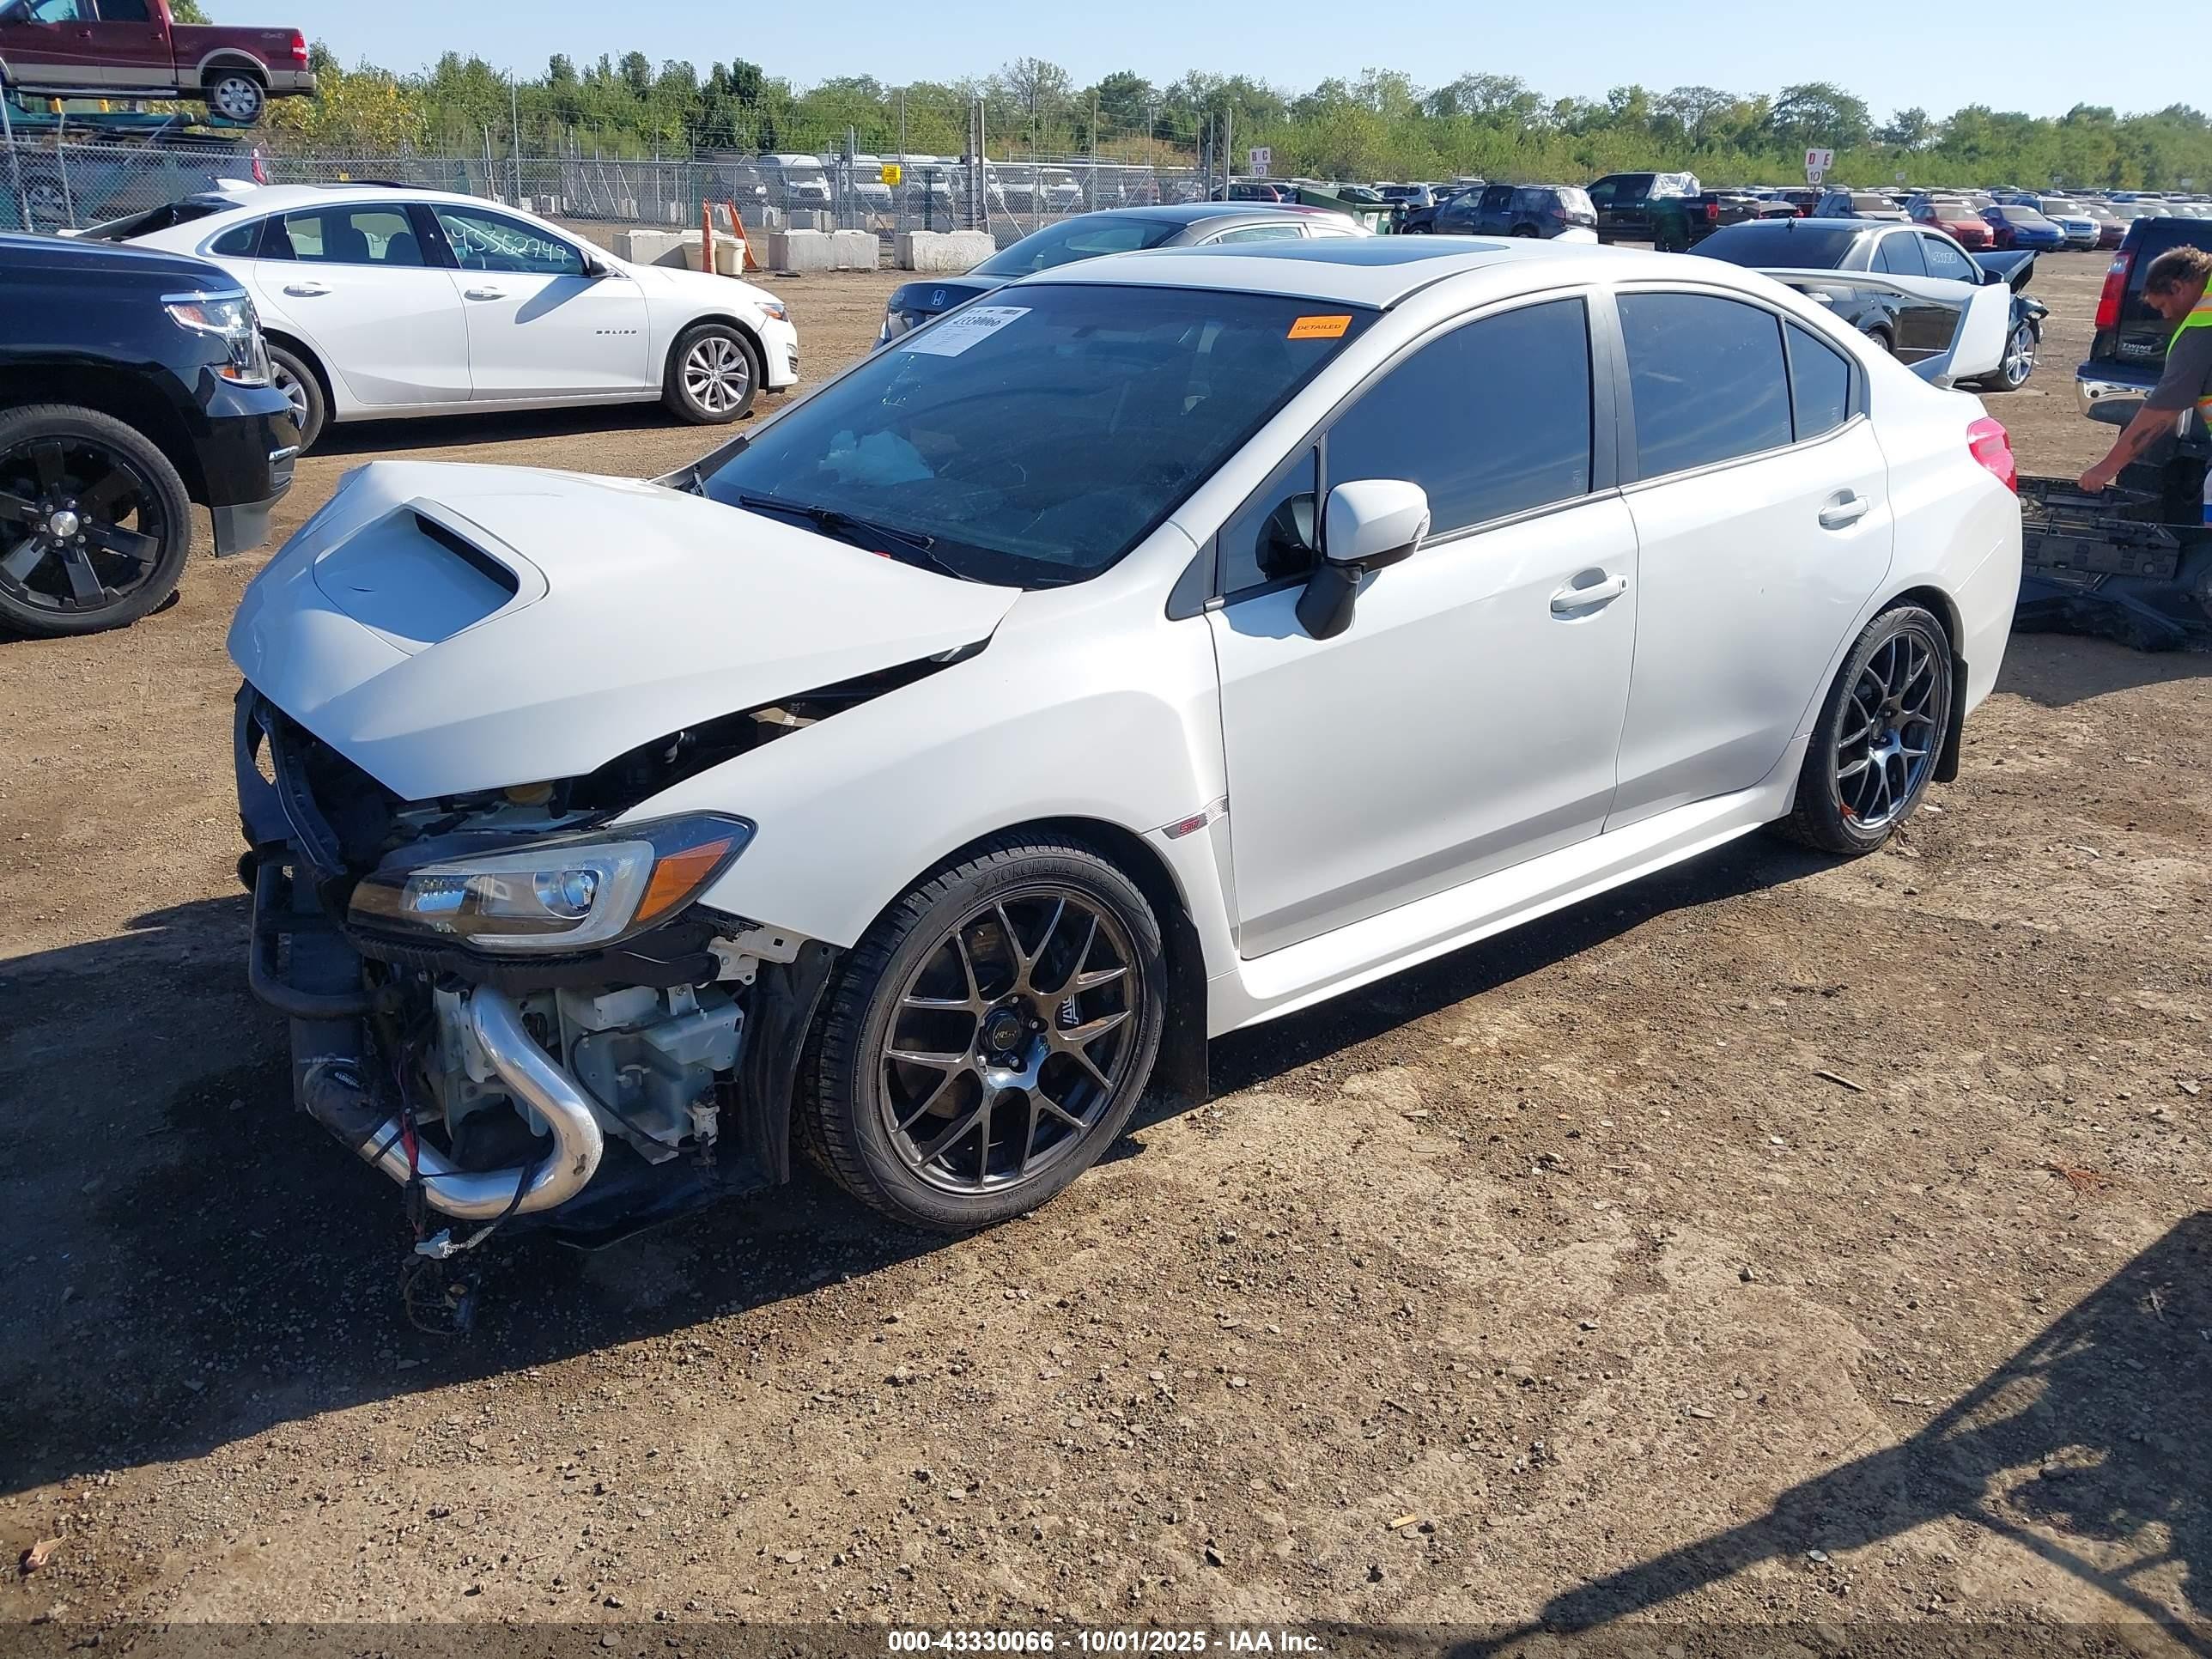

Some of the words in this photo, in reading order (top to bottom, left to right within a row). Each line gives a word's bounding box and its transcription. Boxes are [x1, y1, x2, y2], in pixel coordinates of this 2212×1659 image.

[1251, 151, 1258, 161] B
[1262, 150, 1268, 161] C
[1808, 152, 1816, 165] D
[1822, 153, 1831, 166] E
[1255, 166, 1265, 175] 10
[1810, 171, 1820, 181] 10
